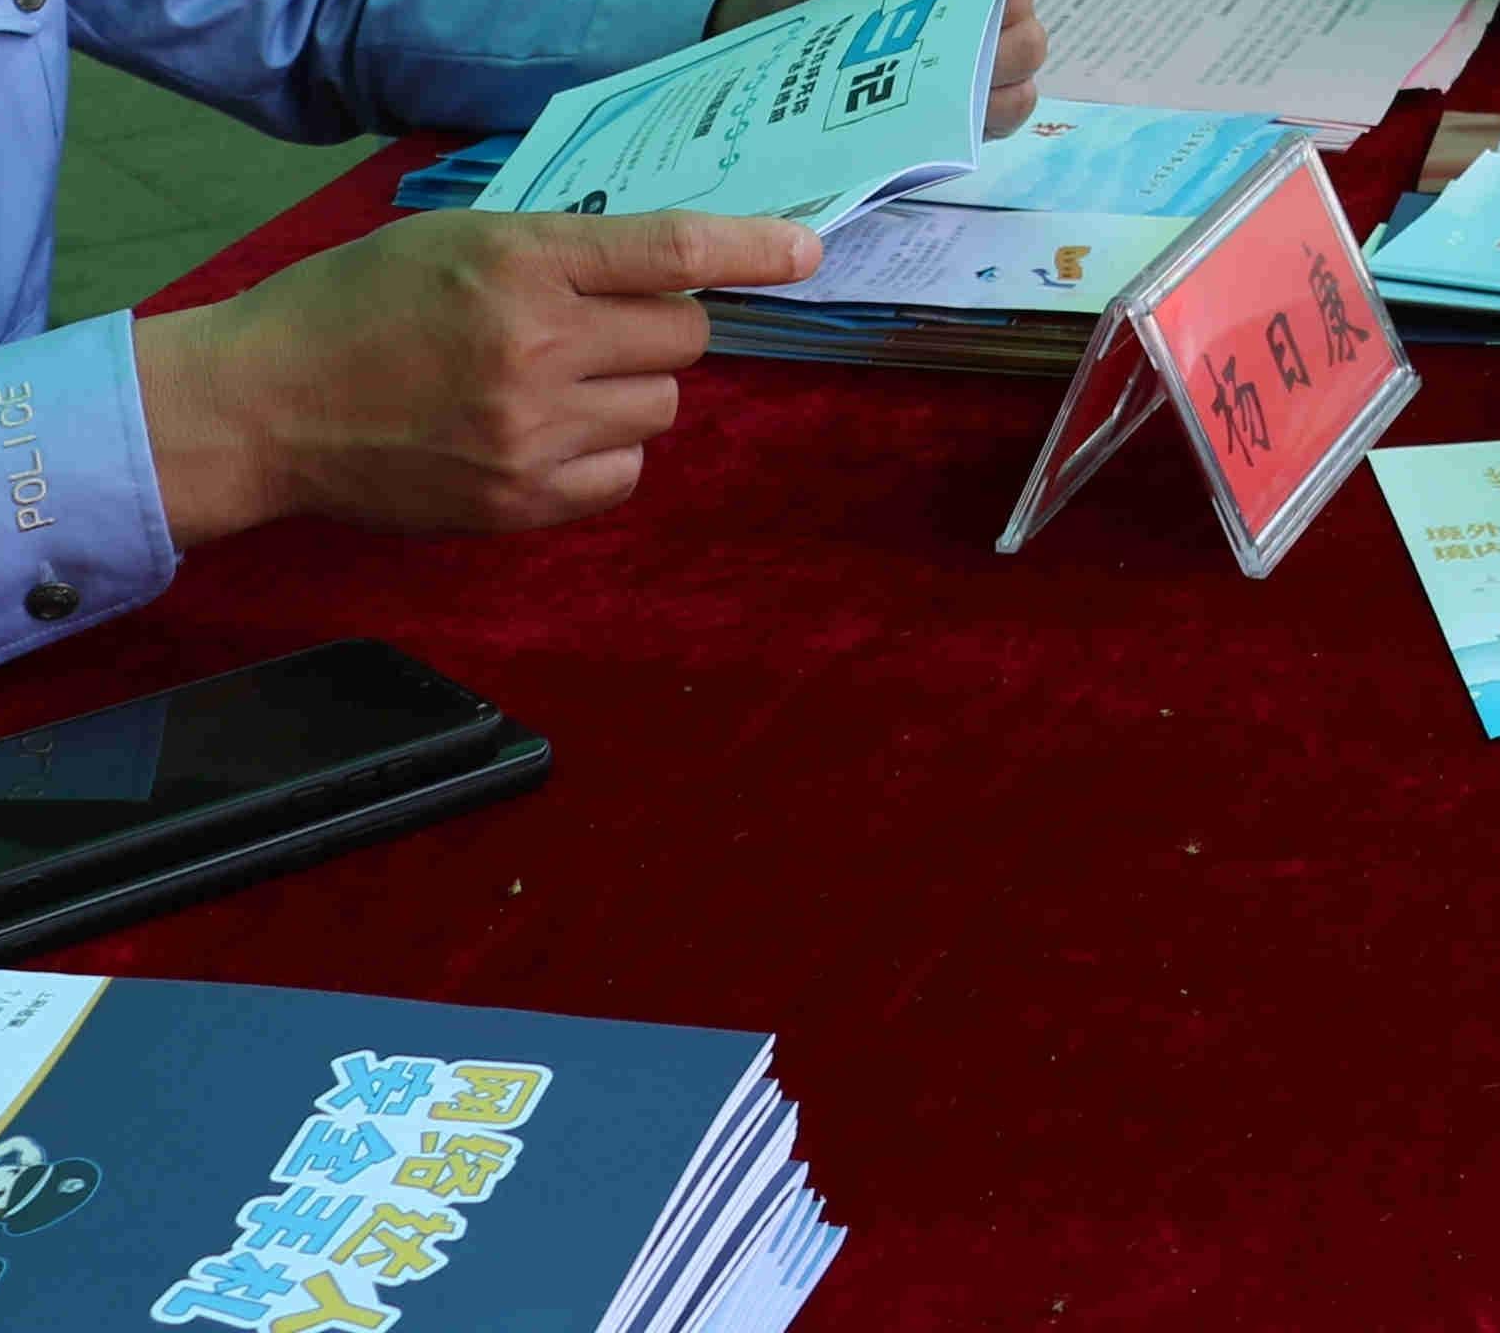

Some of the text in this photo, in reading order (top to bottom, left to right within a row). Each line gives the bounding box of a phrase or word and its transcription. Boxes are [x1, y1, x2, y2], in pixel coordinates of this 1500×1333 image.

[160, 1053, 438, 1323] 安全手札
[268, 1063, 545, 1333] 网络达人
